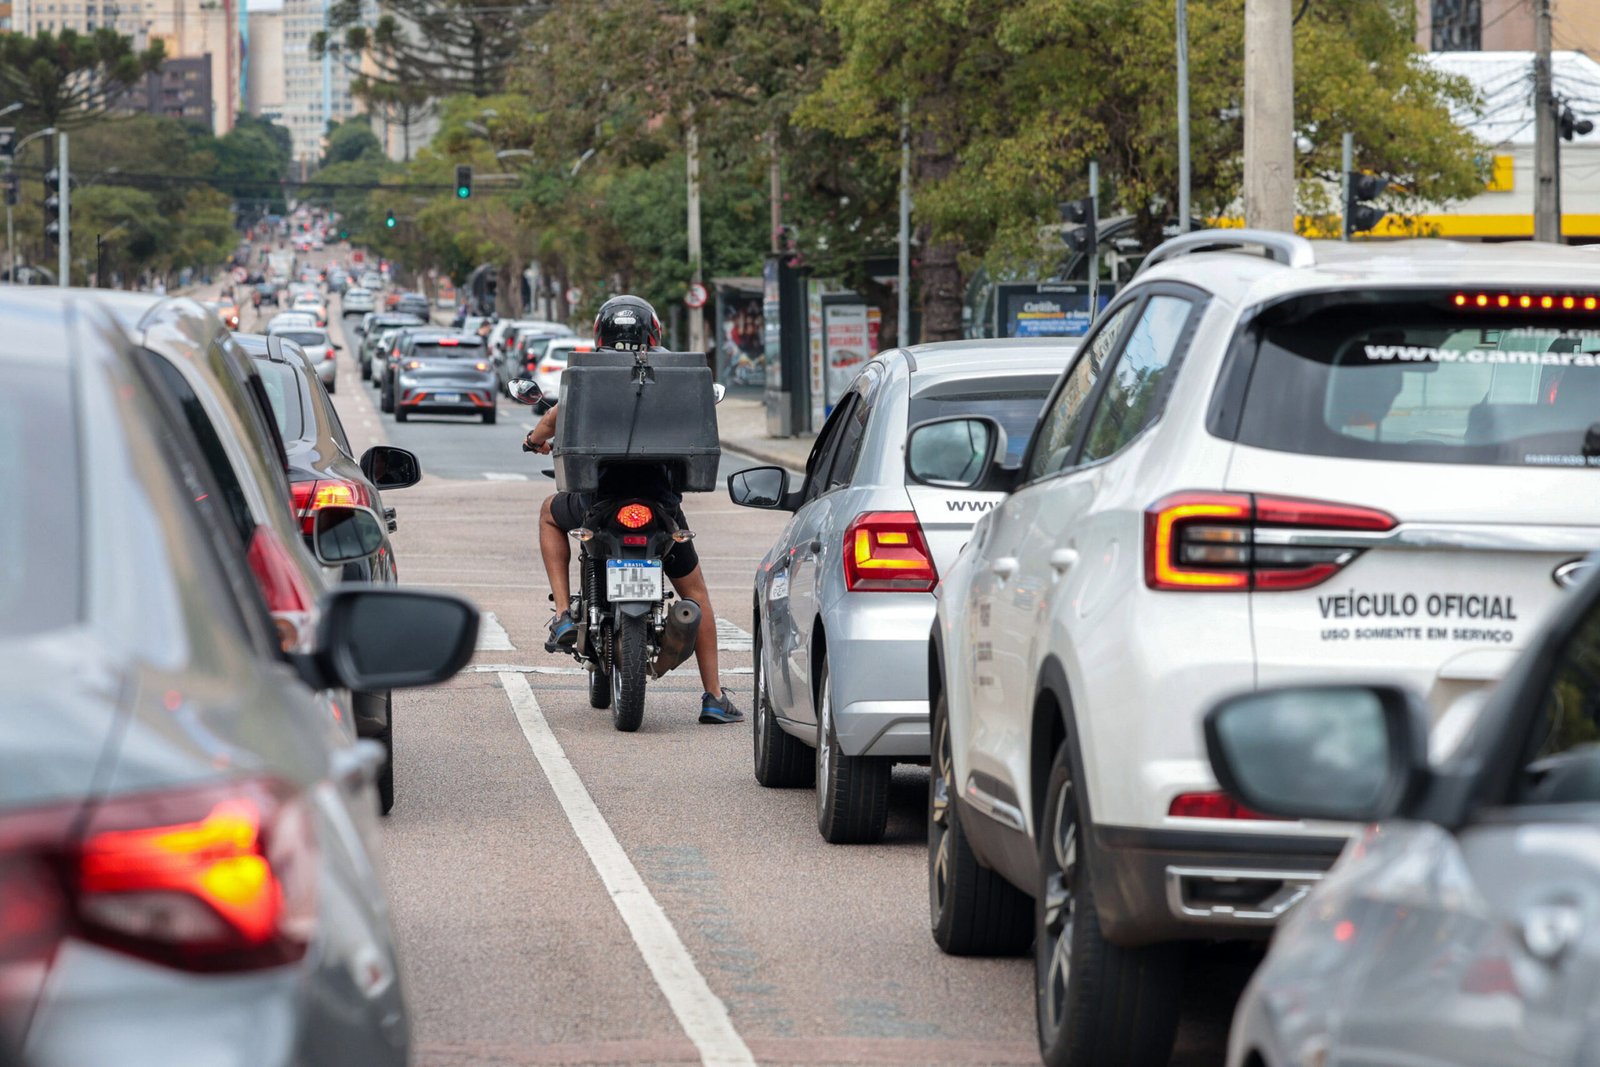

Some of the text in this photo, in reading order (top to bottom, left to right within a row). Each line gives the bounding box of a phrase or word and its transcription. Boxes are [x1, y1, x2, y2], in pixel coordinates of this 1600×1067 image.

[1317, 588, 1517, 620] VEÍCULO OFICIAL
[1321, 627, 1513, 643] USO SOMENTE EM SERVIÇO
